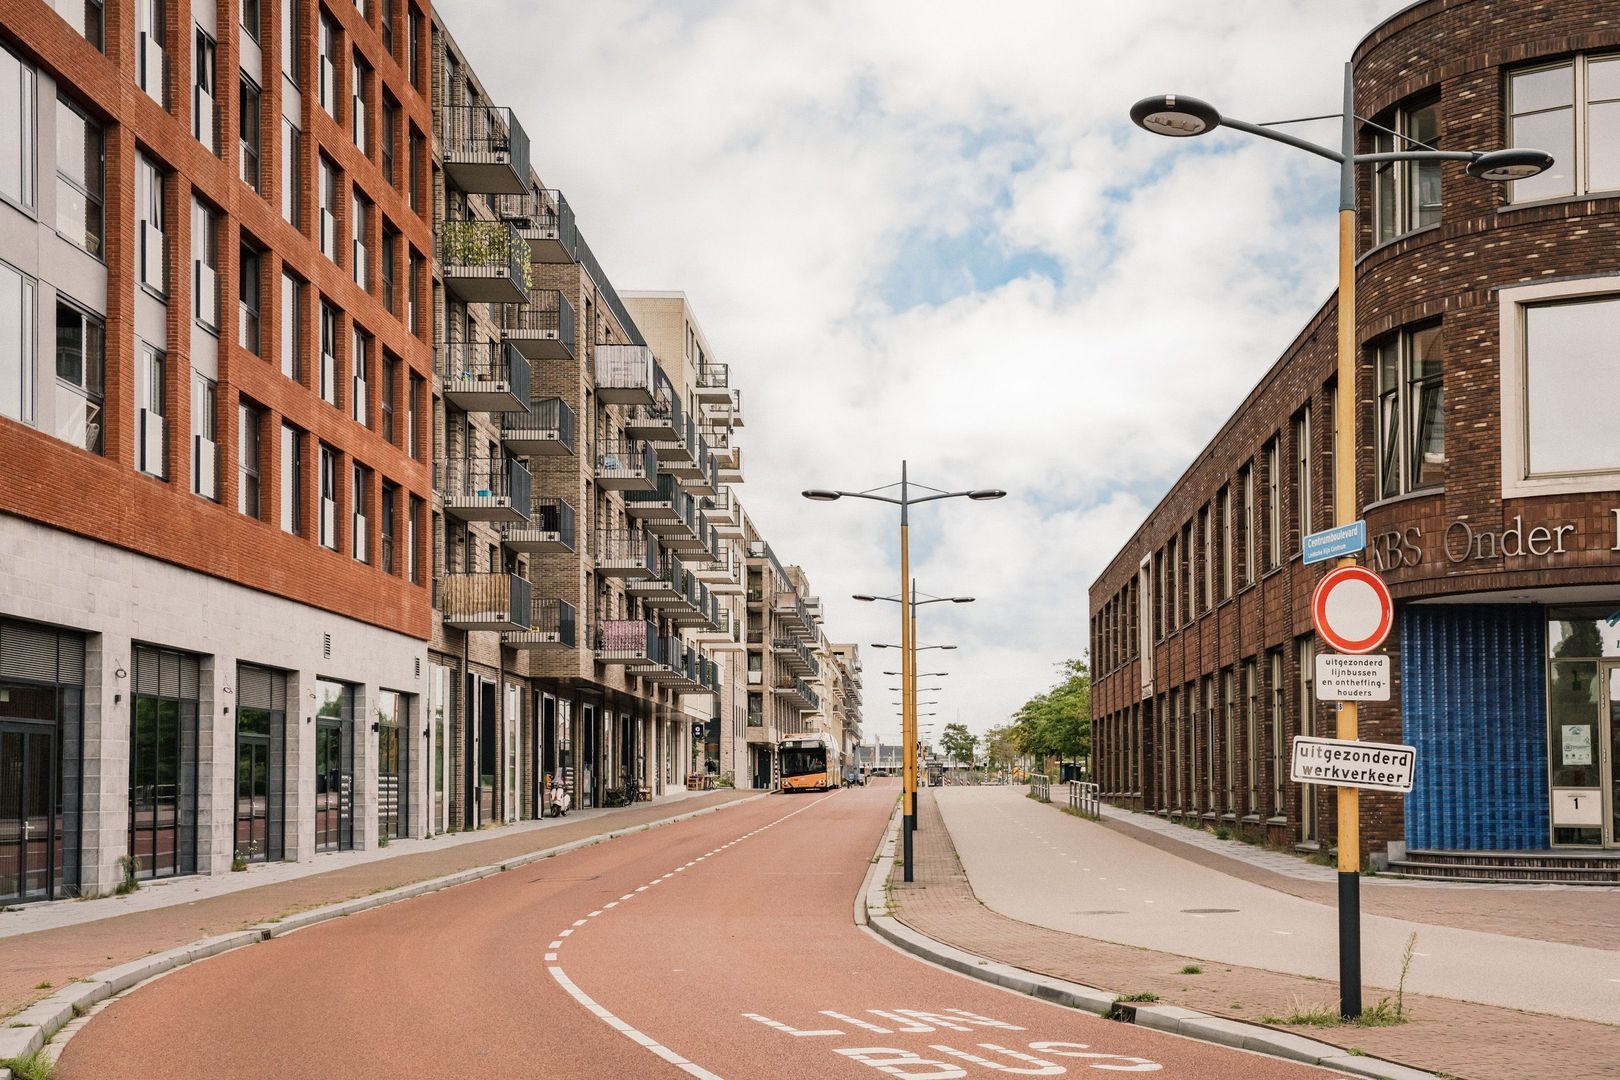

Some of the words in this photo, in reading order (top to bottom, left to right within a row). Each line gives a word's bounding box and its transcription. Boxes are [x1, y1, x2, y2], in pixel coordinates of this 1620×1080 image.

[1307, 525, 1358, 548] Centrumboulevard
[1371, 527, 1422, 572] KBS
[1444, 515, 1575, 563] Onder
[1325, 659, 1383, 667] uitgezonderd
[1331, 669, 1377, 677] lijnbussen
[1335, 679, 1386, 688] ontheffing-
[1300, 745, 1408, 767] uitgezonderd
[1302, 765, 1403, 783] werkverkeer
[741, 1009, 1029, 1036] LIJN
[832, 1041, 1163, 1080] BUS
